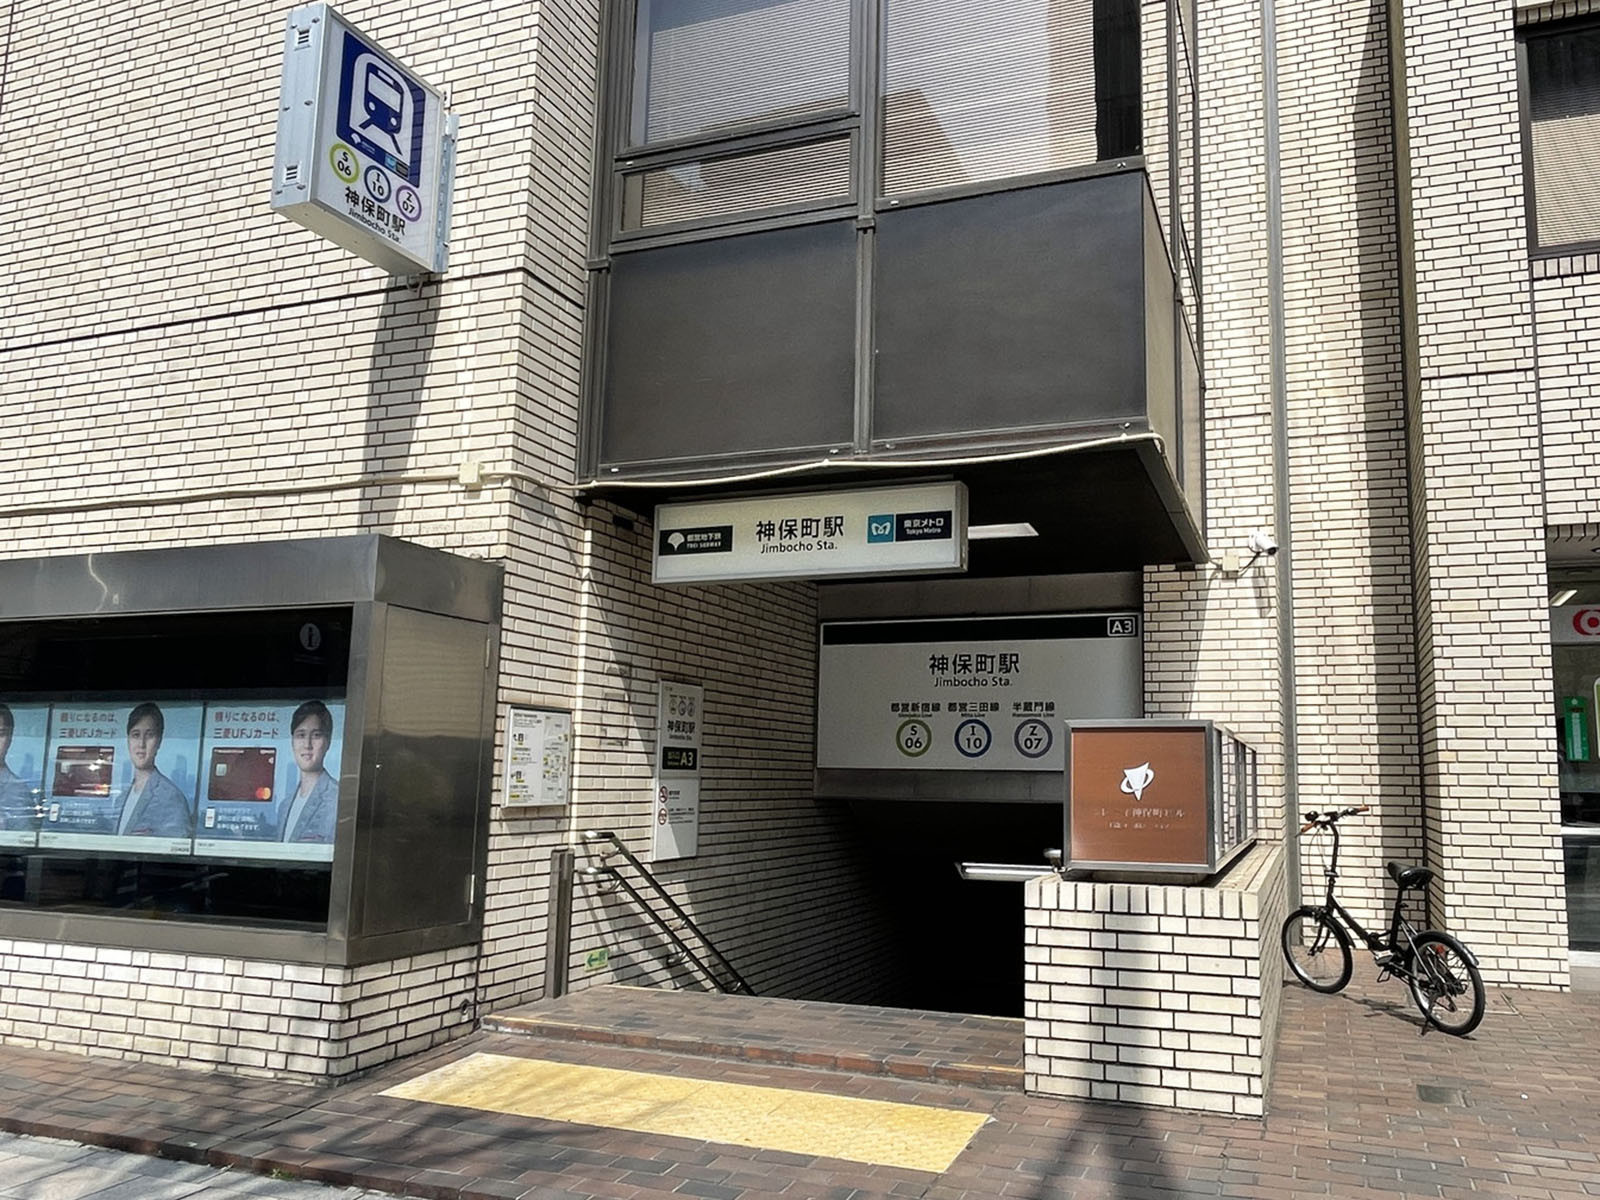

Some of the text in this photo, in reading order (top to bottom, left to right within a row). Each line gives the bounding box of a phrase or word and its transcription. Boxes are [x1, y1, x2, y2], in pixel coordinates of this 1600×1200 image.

[342, 151, 349, 162] S
[337, 160, 352, 176] 06
[375, 172, 382, 183] I
[372, 181, 385, 196] 10
[406, 191, 413, 203] Z
[345, 186, 406, 236] 神保町駅
[402, 200, 416, 214] 07
[348, 207, 402, 244] Jimbocho Sta.
[755, 515, 845, 542] 神保町駅
[903, 517, 944, 528] 東京メトロ
[906, 526, 942, 536] Tokyo Metro
[760, 540, 838, 554] Jimbocho Sta.
[1111, 619, 1133, 634] A3
[928, 652, 1020, 676] 神保町駅
[934, 676, 1013, 688] Jimbocho Sta.
[1012, 701, 1056, 712] 半蔵門線
[213, 728, 279, 739] 三菱UFJカード
[910, 726, 918, 736] S
[969, 725, 977, 736] I
[1029, 725, 1038, 736] Z
[904, 737, 923, 750] 06
[965, 737, 983, 749] 10
[1023, 737, 1043, 750] 07
[680, 751, 694, 767] A3
